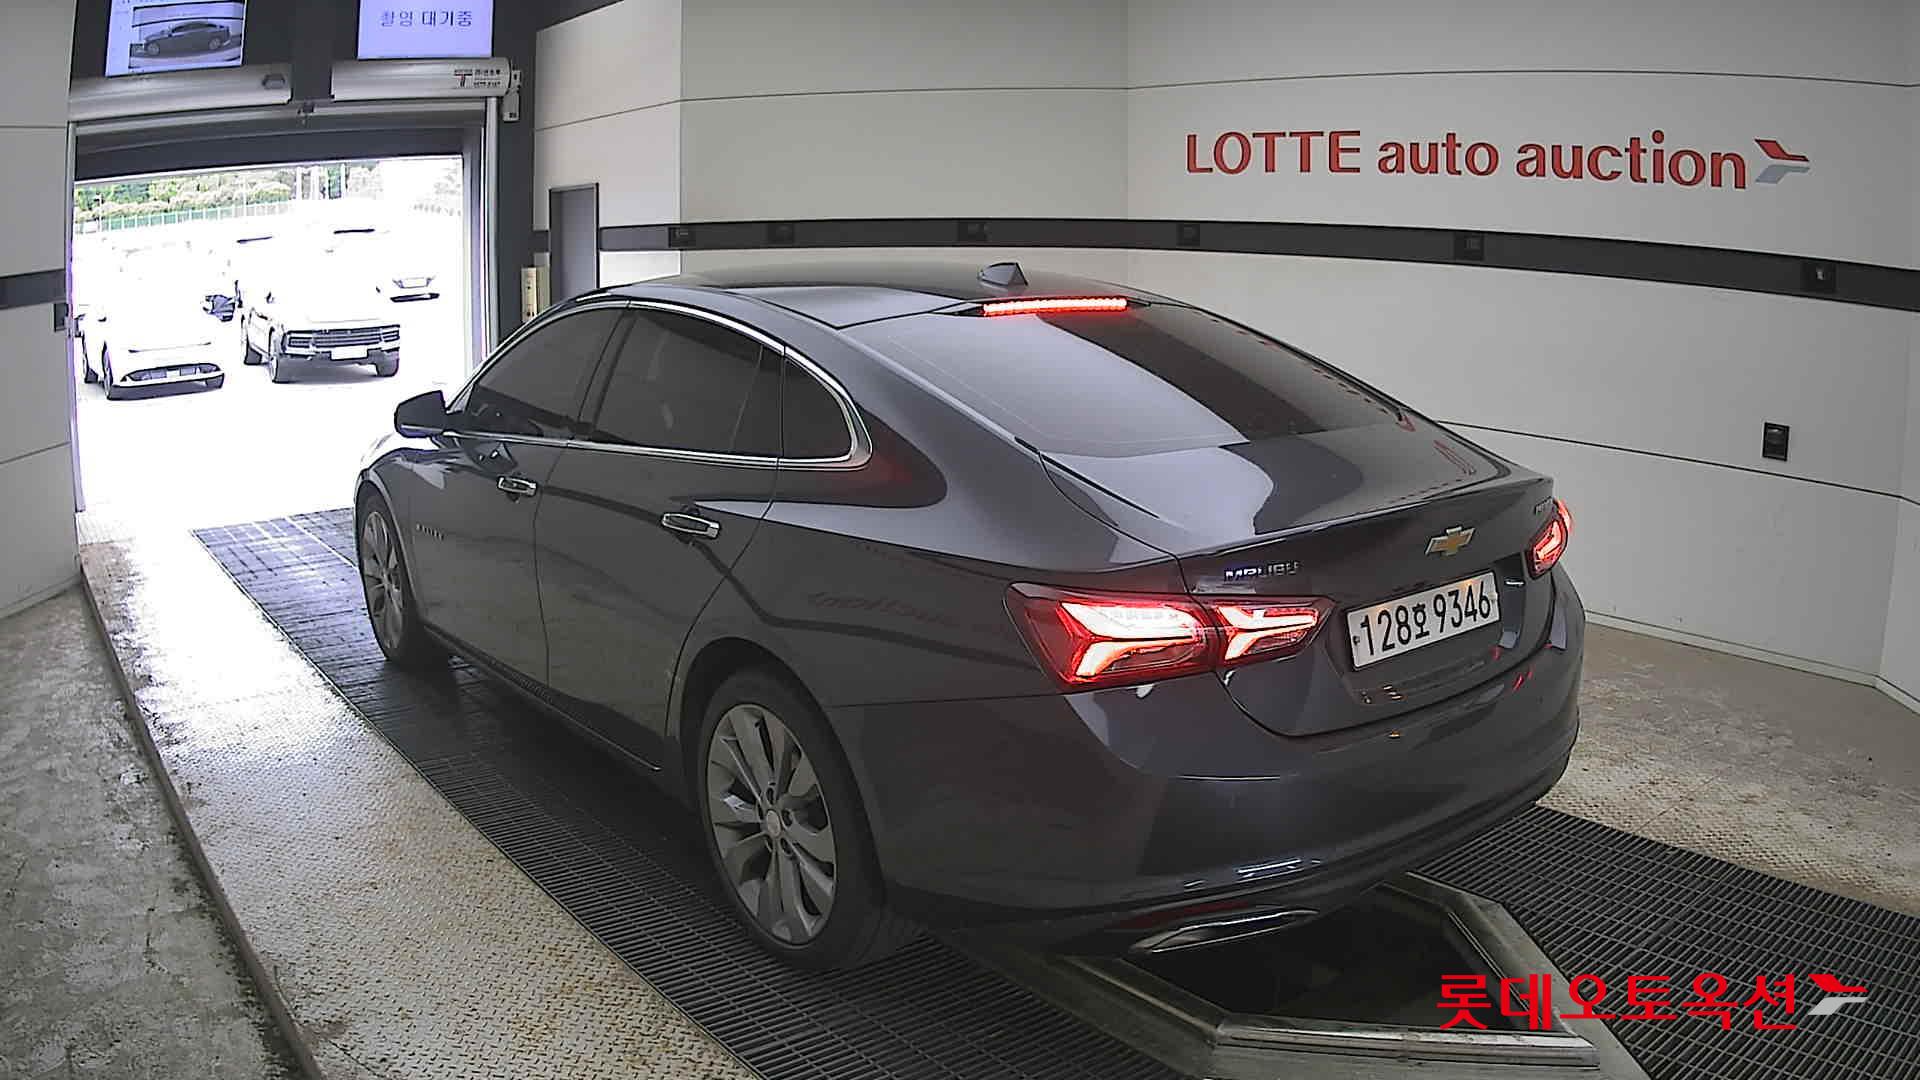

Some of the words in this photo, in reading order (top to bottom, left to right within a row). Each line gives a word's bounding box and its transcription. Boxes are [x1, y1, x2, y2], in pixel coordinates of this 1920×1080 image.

[421, 10, 473, 27] 대기중
[1186, 130, 1361, 175] LOTTE
[1377, 132, 1500, 177] auto
[1515, 129, 1747, 190] auction
